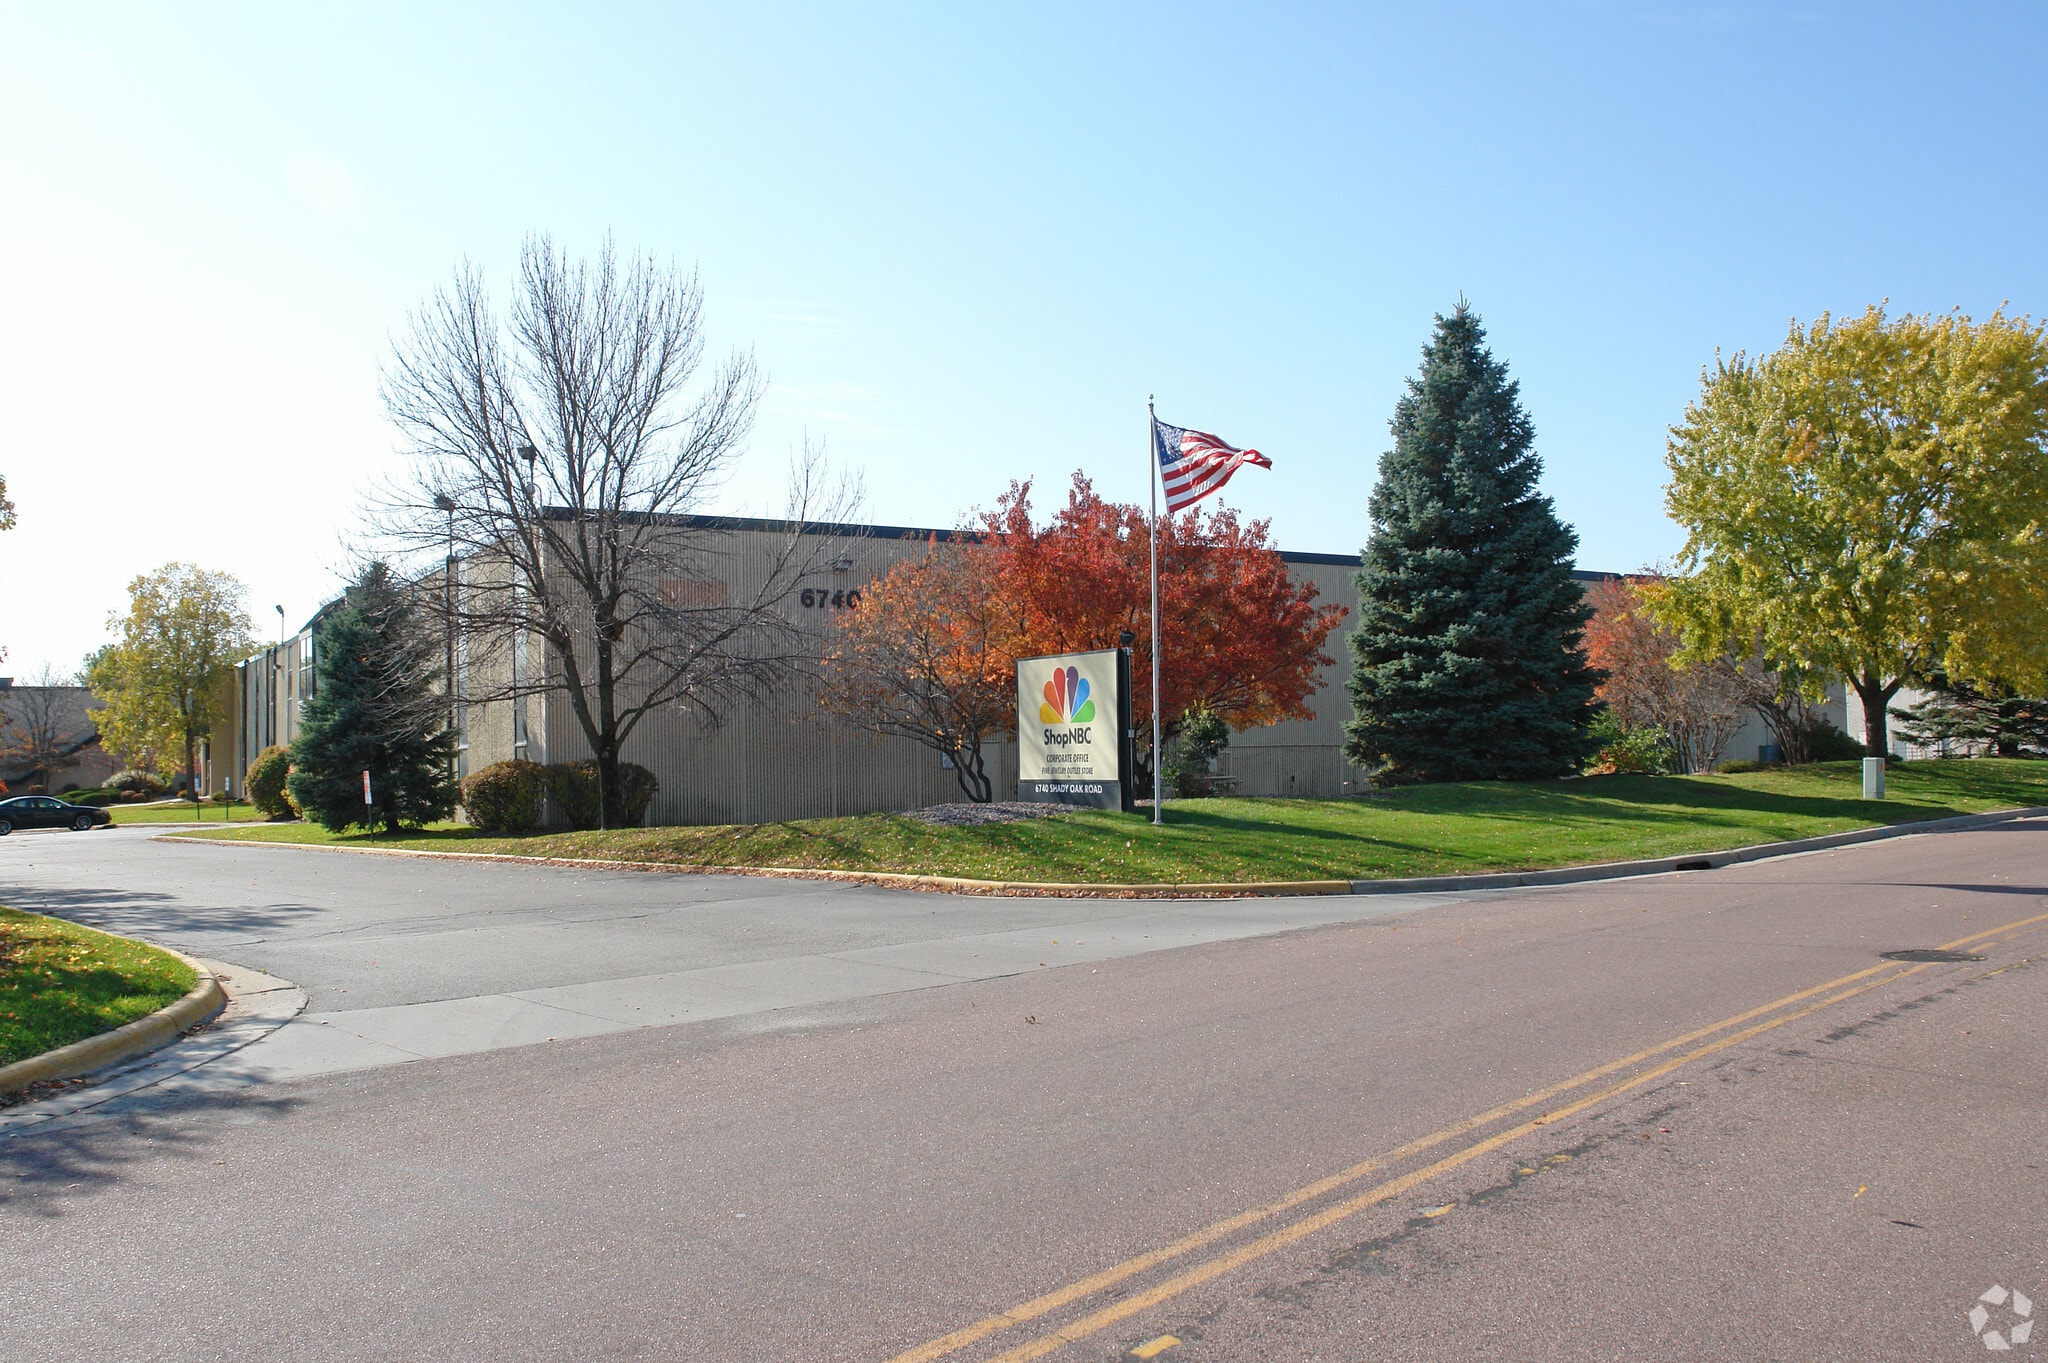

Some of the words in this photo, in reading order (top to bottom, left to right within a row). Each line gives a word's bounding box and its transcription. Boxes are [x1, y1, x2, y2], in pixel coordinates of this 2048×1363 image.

[801, 588, 861, 609] 6740
[1044, 727, 1091, 748] ShopNBC
[1046, 754, 1072, 762] CORPORATE
[1073, 754, 1089, 762] OFFICE
[1035, 784, 1049, 792] 6740
[1050, 784, 1068, 792] SHADY
[1070, 785, 1083, 793] OAK
[1085, 785, 1102, 793] ROAD
